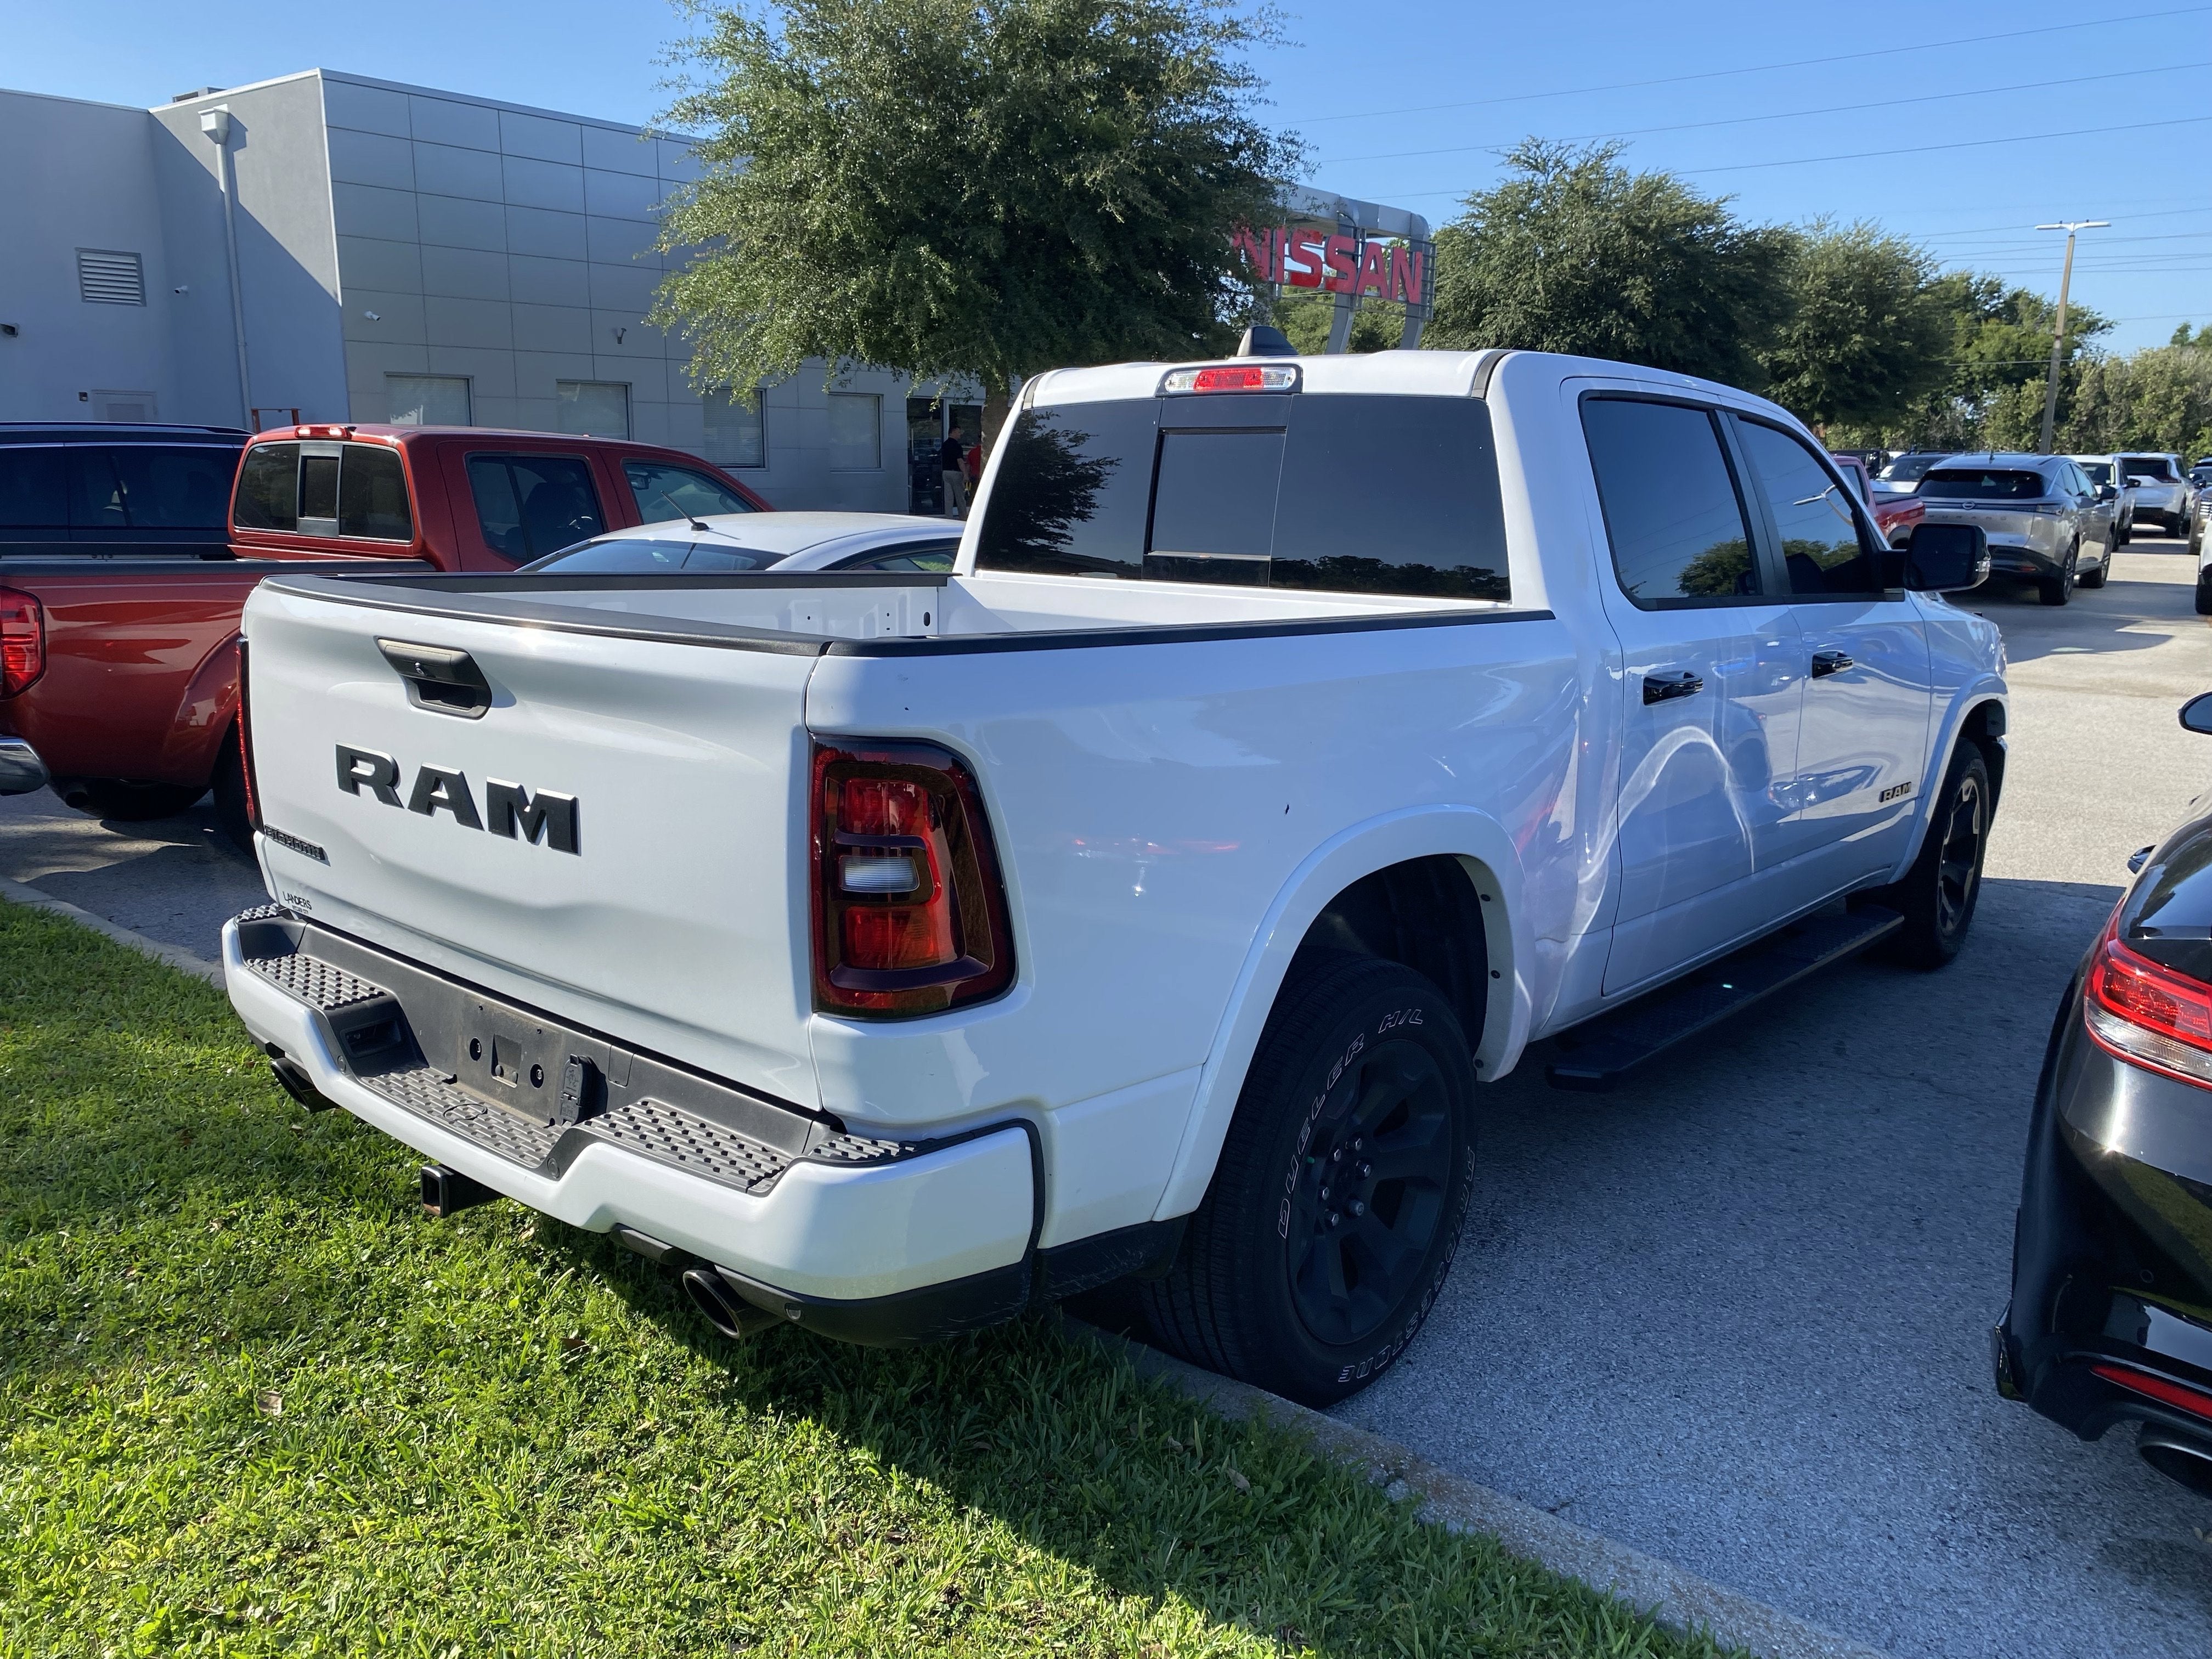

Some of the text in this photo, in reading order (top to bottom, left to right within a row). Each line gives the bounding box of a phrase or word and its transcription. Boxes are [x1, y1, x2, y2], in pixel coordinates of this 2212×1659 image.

[1232, 222, 1423, 304] NISSAN
[335, 741, 582, 856] RAM
[1878, 781, 1912, 803] RAM
[283, 891, 312, 910] LANDERS
[1278, 1008, 1424, 1239] DUELER H/L
[1338, 1145, 1476, 1384] BRIDGESTONE
